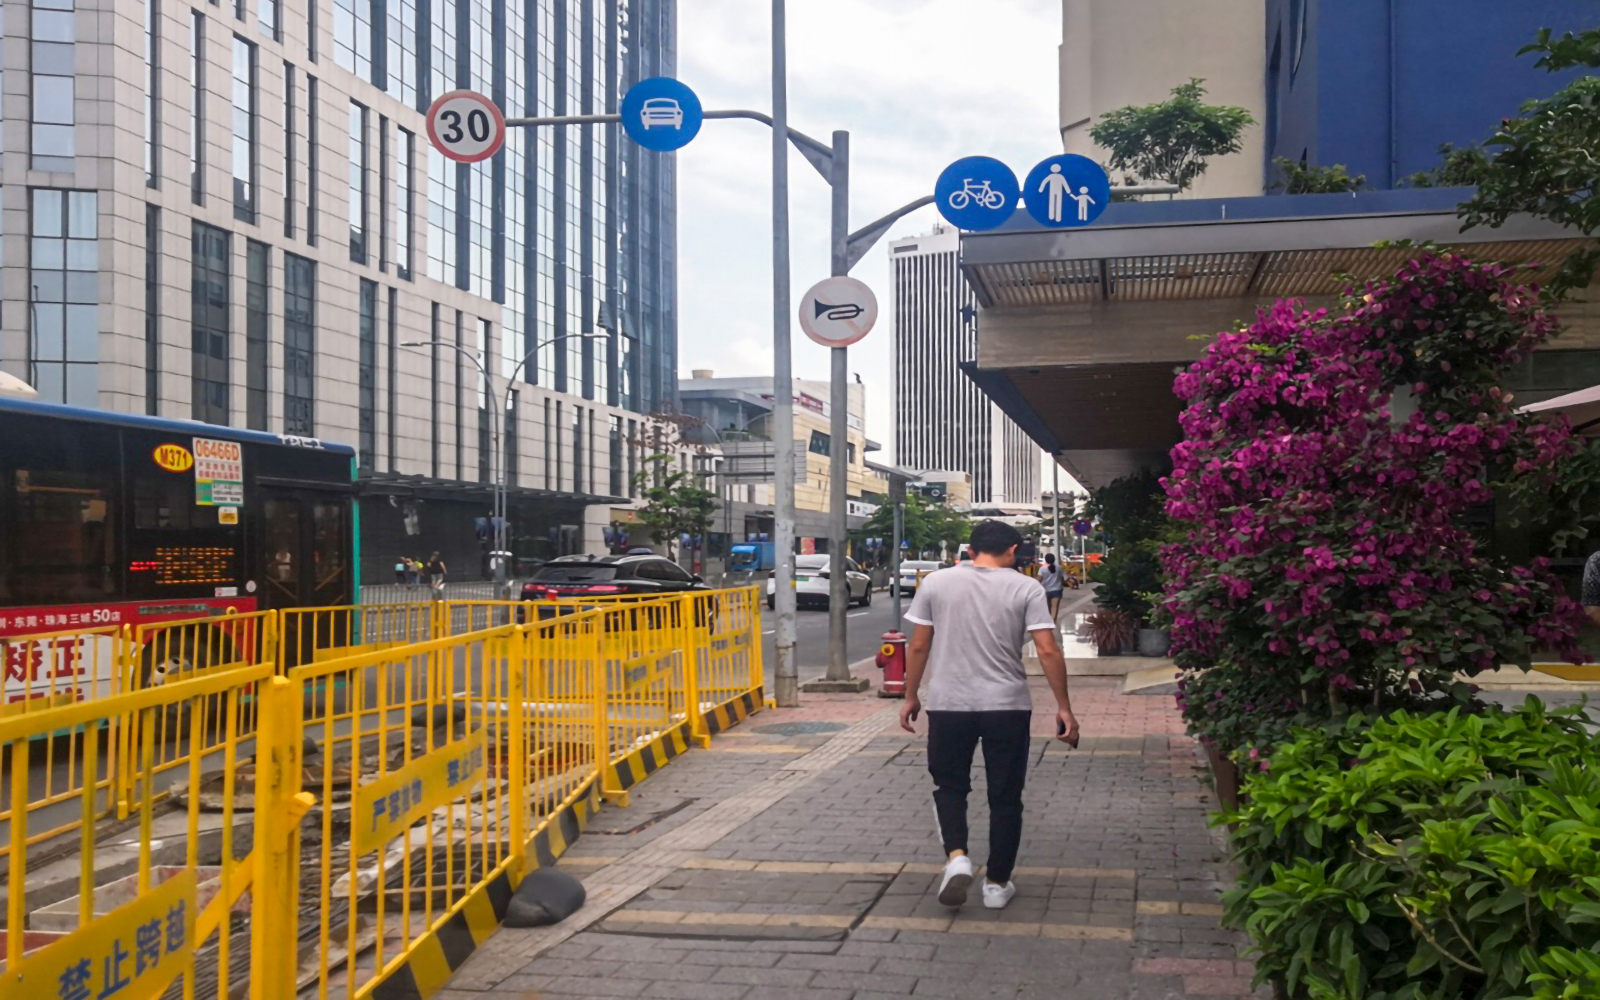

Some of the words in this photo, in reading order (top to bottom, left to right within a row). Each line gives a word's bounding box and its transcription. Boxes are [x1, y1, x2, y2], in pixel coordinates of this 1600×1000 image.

[440, 109, 490, 143] 30
[160, 447, 188, 468] M371
[195, 439, 240, 462] 06466D
[57, 898, 187, 1000] 禁止跨越
